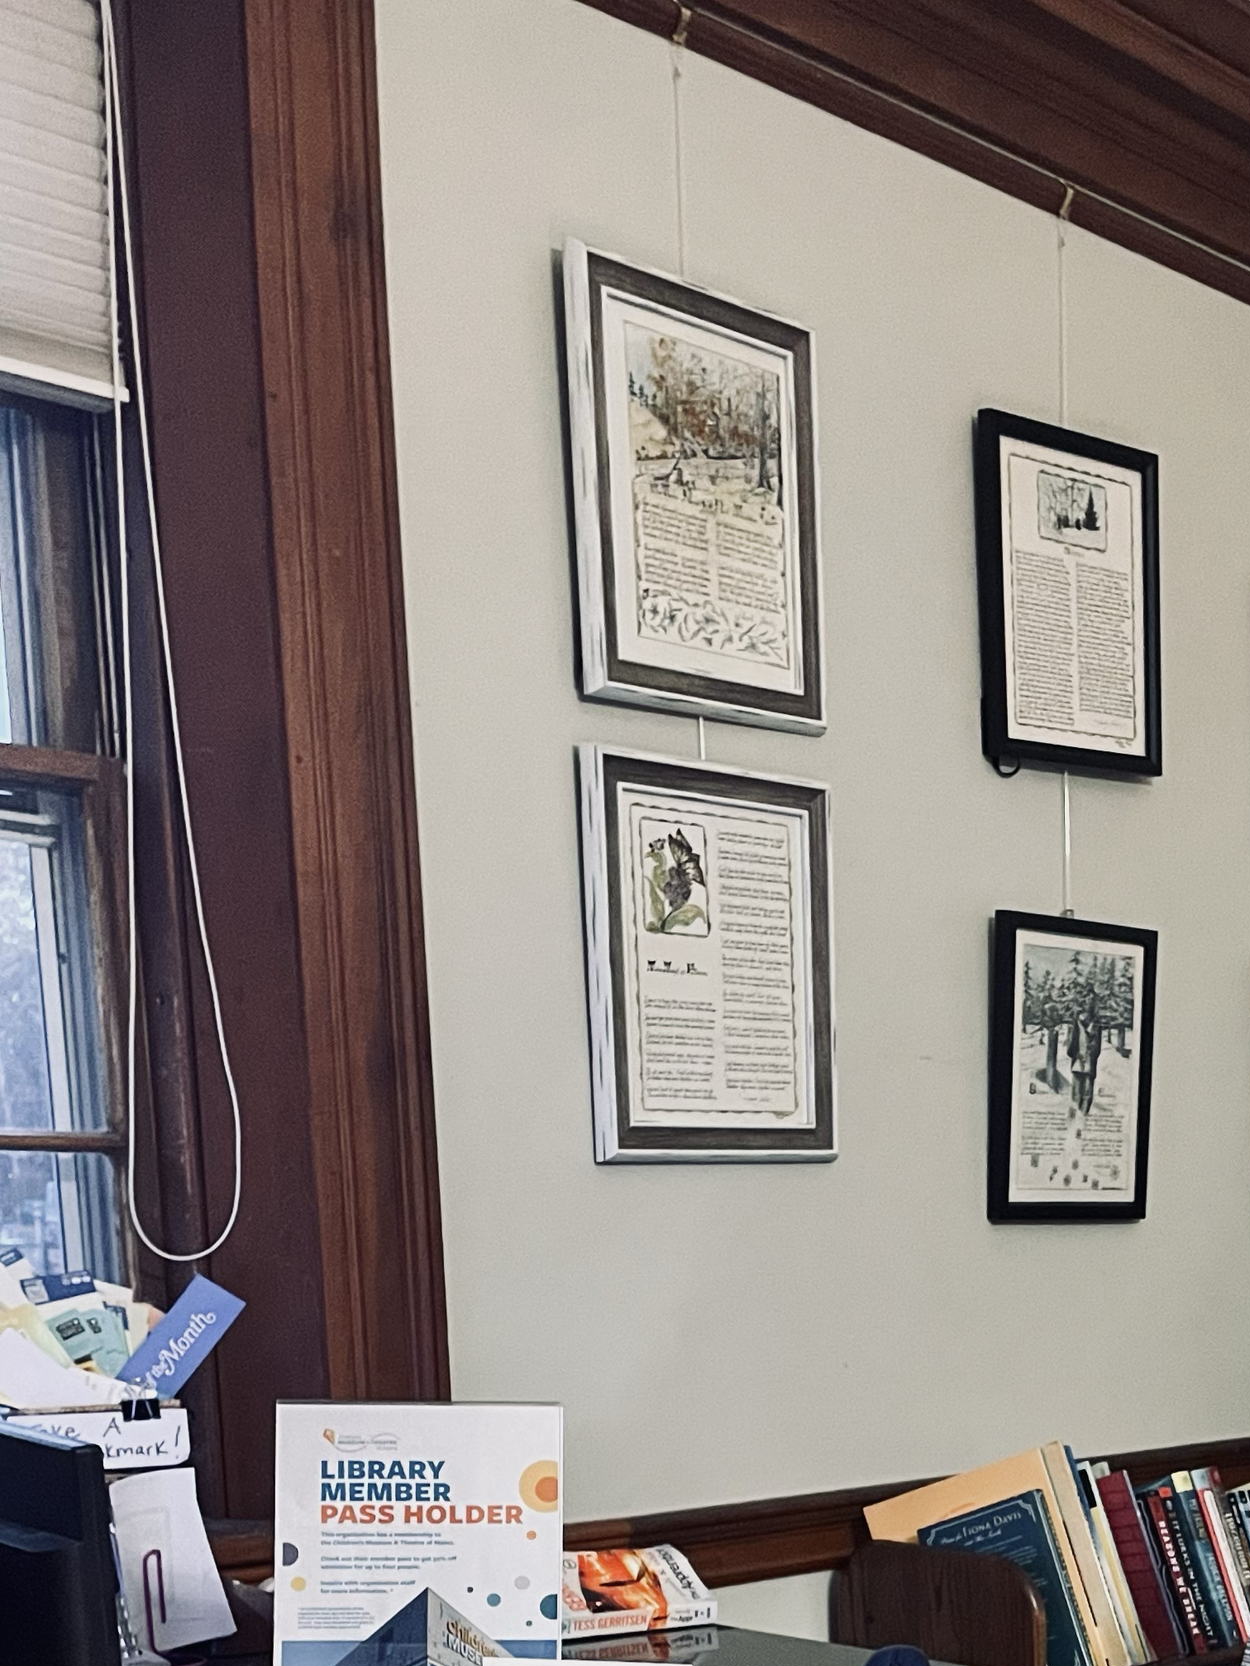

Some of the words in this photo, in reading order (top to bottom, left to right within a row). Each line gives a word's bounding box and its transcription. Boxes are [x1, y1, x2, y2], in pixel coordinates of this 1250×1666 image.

[164, 1311, 217, 1377] Month
[103, 1417, 121, 1437] A
[321, 1460, 445, 1479] LIBRARY
[321, 1483, 451, 1502] MEMBER
[321, 1505, 394, 1524] PASS
[404, 1505, 523, 1525] HOLDER
[1171, 1520, 1180, 1531] IT
[1175, 1532, 1192, 1566] LURKS
[1157, 1520, 1181, 1574] REASONS
[1175, 1576, 1187, 1595] WE
[1182, 1598, 1201, 1636] BREAK
[1186, 1567, 1196, 1580] IN
[1191, 1583, 1203, 1602] THE
[573, 1620, 596, 1631] TESS
[598, 1615, 647, 1629] GERRITSEN
[1198, 1604, 1214, 1638] NIGHT
